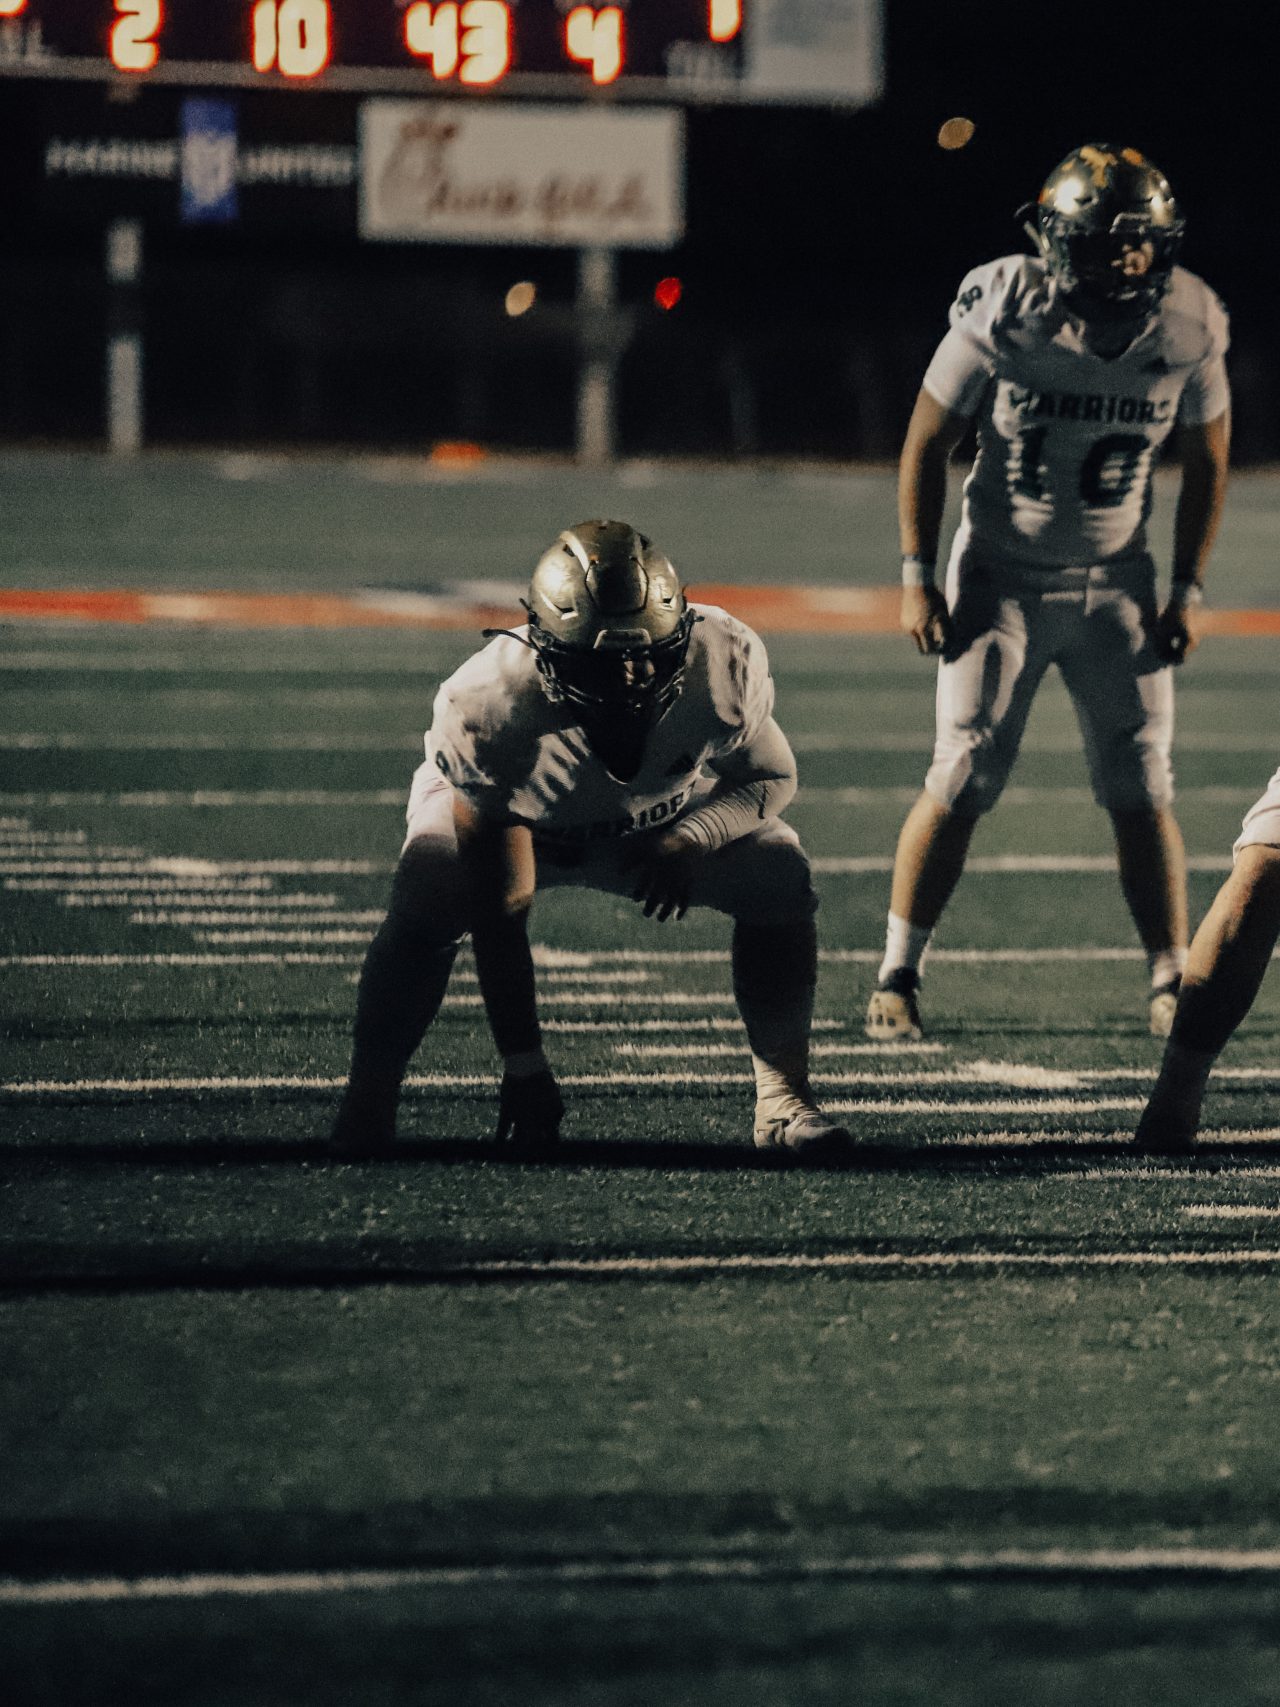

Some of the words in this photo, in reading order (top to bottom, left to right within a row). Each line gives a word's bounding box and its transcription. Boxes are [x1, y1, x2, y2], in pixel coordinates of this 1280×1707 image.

[109, 0, 165, 71] 2
[251, 0, 332, 77] 10
[404, 0, 510, 84] 43
[565, 3, 624, 84] 4
[1009, 388, 1171, 423] WARRIORS
